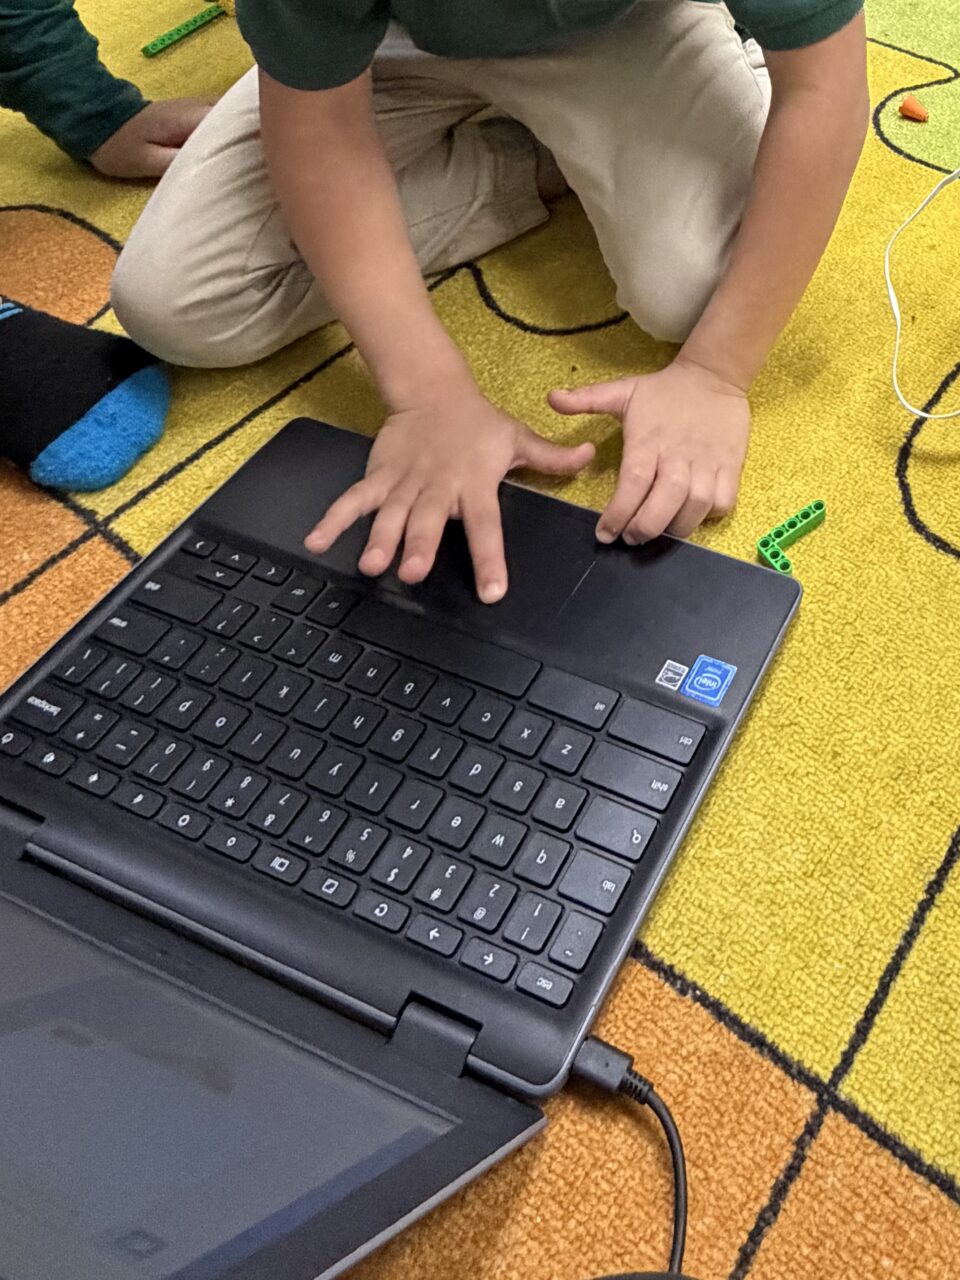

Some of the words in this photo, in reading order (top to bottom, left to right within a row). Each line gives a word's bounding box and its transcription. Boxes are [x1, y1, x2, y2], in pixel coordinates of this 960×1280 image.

[328, 652, 343, 664] m
[366, 667, 378, 678] n
[403, 682, 415, 695] b
[178, 700, 193, 712] p
[352, 715, 365, 729] h
[391, 728, 405, 742] g
[679, 736, 692, 745] ctrl
[201, 759, 215, 772] 9
[328, 762, 343, 776] y
[468, 763, 482, 776] d
[239, 775, 253, 789] 8
[651, 780, 668, 792] shift
[554, 797, 566, 809] a
[318, 809, 331, 823] 6
[450, 815, 462, 828] e
[359, 827, 372, 841] 5
[491, 833, 505, 847] w
[535, 848, 547, 865] q
[444, 864, 457, 879] 3
[488, 883, 501, 898] 2
[603, 880, 615, 892] tab
[473, 906, 487, 921] @
[537, 977, 552, 990] esc
